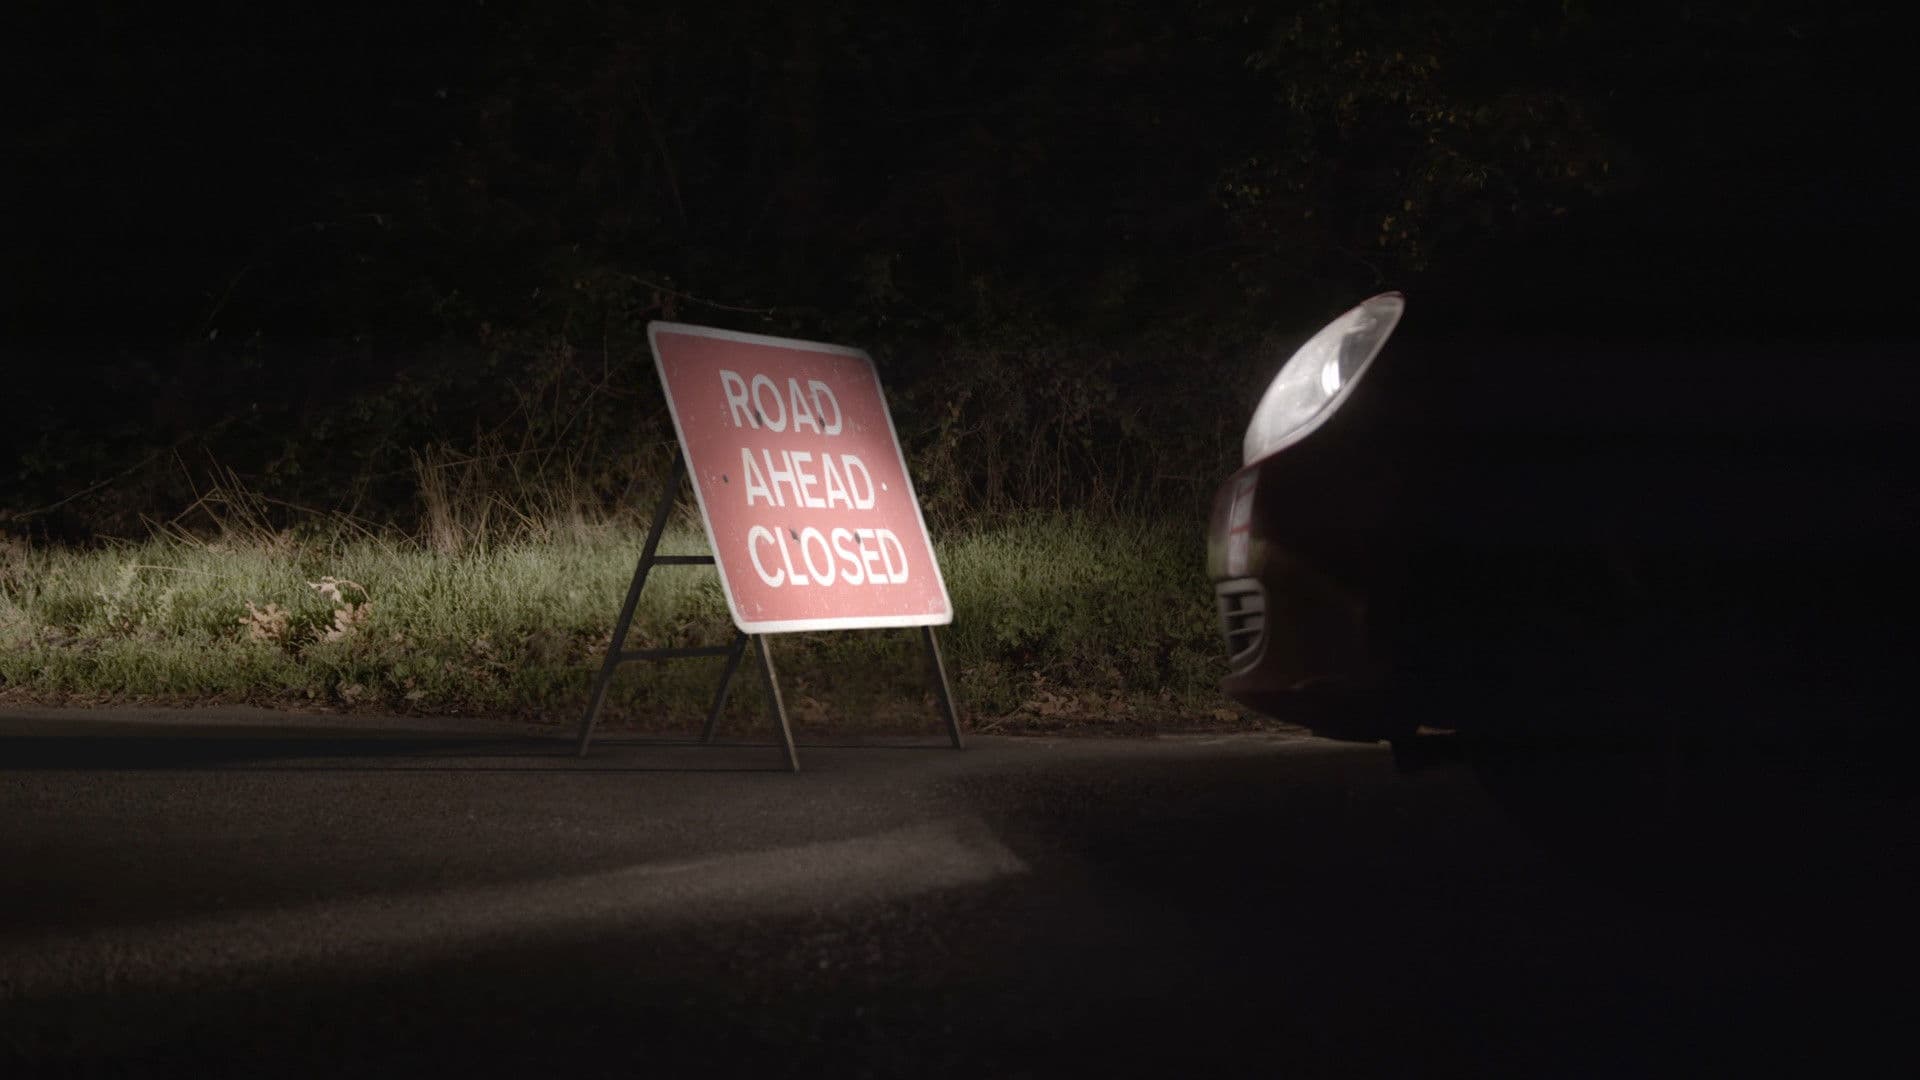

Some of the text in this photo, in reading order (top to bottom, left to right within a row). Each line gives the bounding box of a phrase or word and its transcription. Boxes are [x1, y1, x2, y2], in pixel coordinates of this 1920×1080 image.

[719, 369, 843, 436] ROAD
[741, 447, 875, 510] AHEAD
[747, 525, 909, 588] CLOSED
